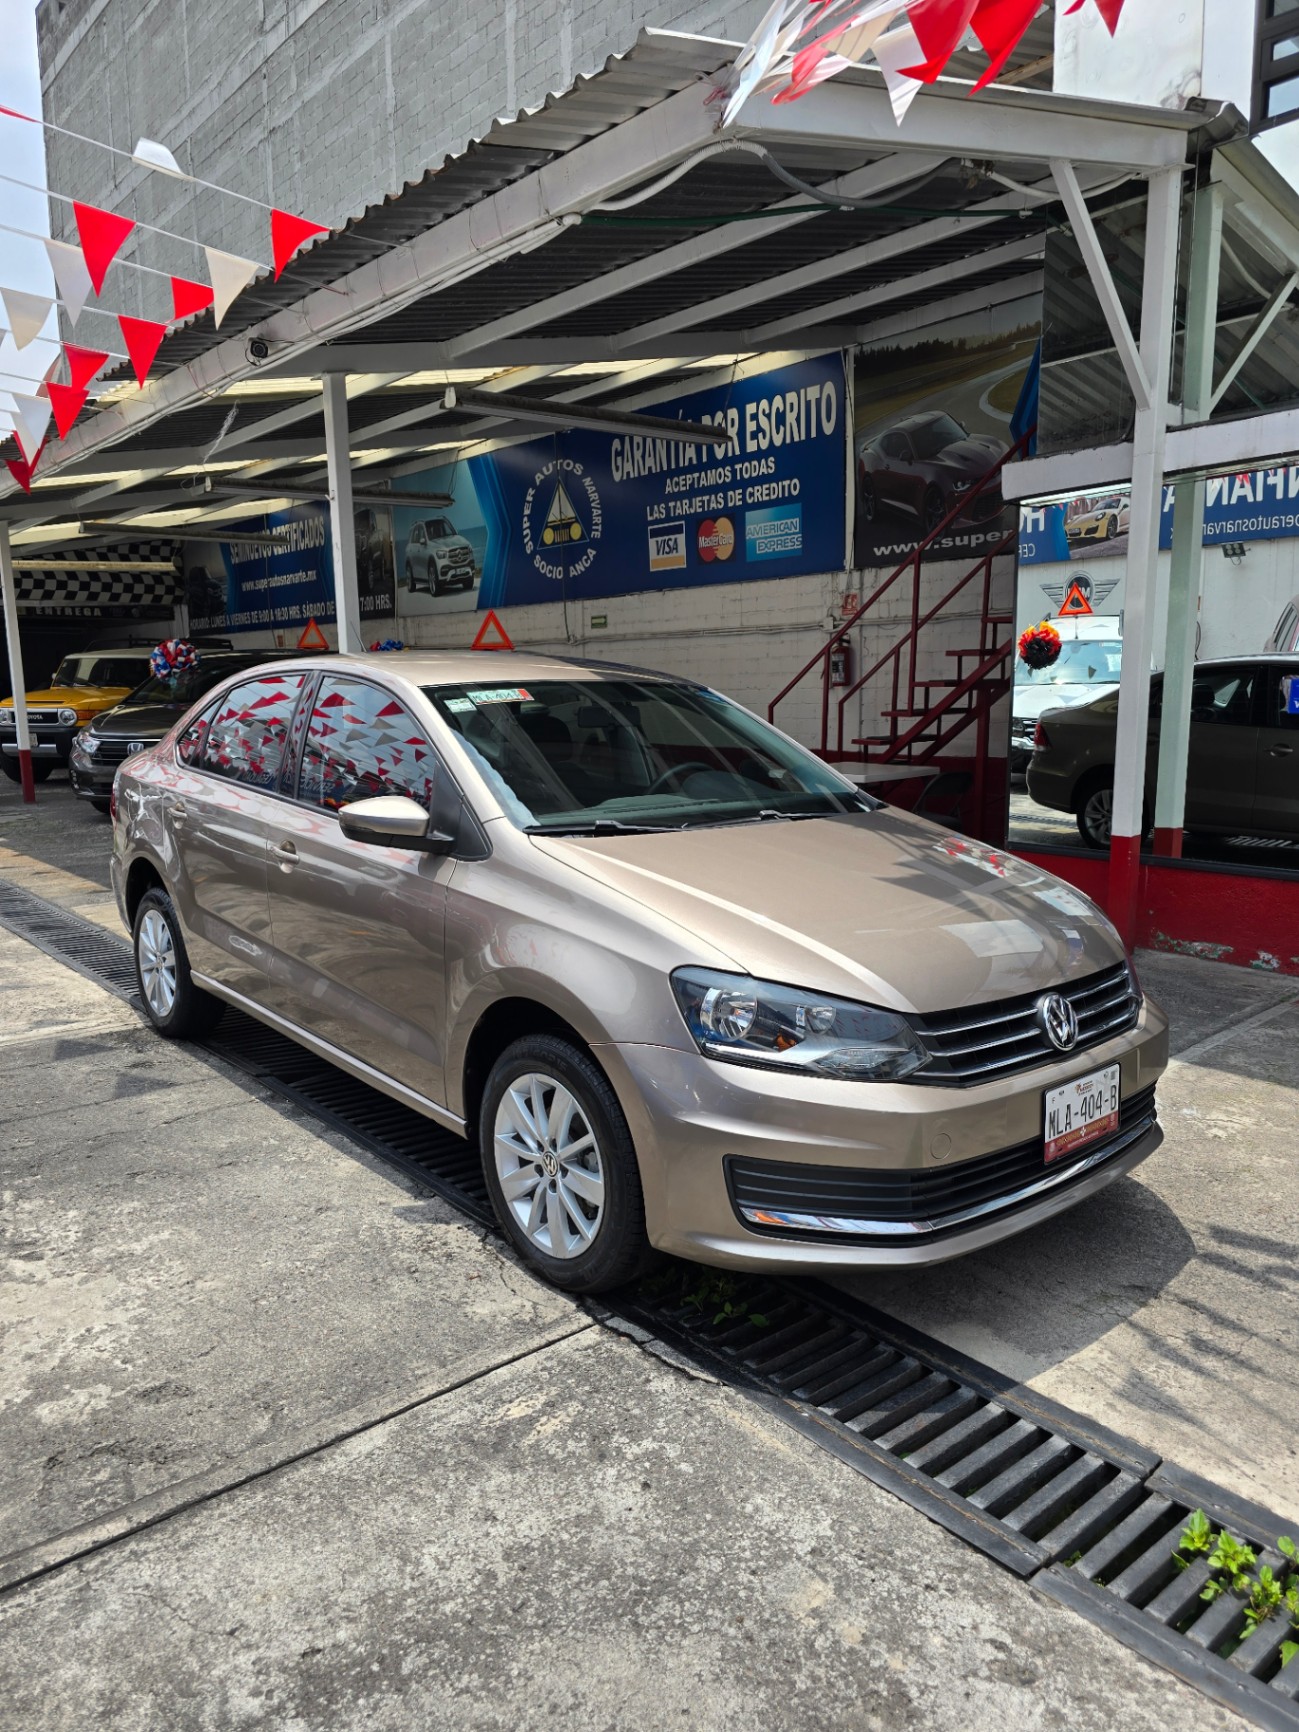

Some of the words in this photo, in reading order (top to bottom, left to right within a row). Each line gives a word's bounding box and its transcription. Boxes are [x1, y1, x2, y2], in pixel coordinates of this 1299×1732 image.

[702, 408, 740, 463] POR
[745, 381, 837, 453] ESCRITO
[665, 468, 732, 494] ACEPTAMOS
[735, 456, 775, 480] TODAS
[522, 487, 536, 554] SUPER
[534, 459, 584, 486] AUTOS
[582, 477, 602, 539] NARVARTE
[647, 504, 665, 521] LAS
[669, 494, 725, 517] TARJETAS
[728, 489, 743, 507] DE
[746, 478, 800, 503] CREDITO
[698, 534, 733, 548] MasterCard
[746, 519, 799, 538] AMERICAN
[655, 536, 679, 556] VISA
[757, 534, 802, 553] EXPRESS
[533, 555, 564, 579] SOCIO
[569, 548, 597, 577] ANCA
[302, 601, 326, 618] SÁBADO
[327, 602, 335, 615] DE
[375, 594, 393, 610] HRS.
